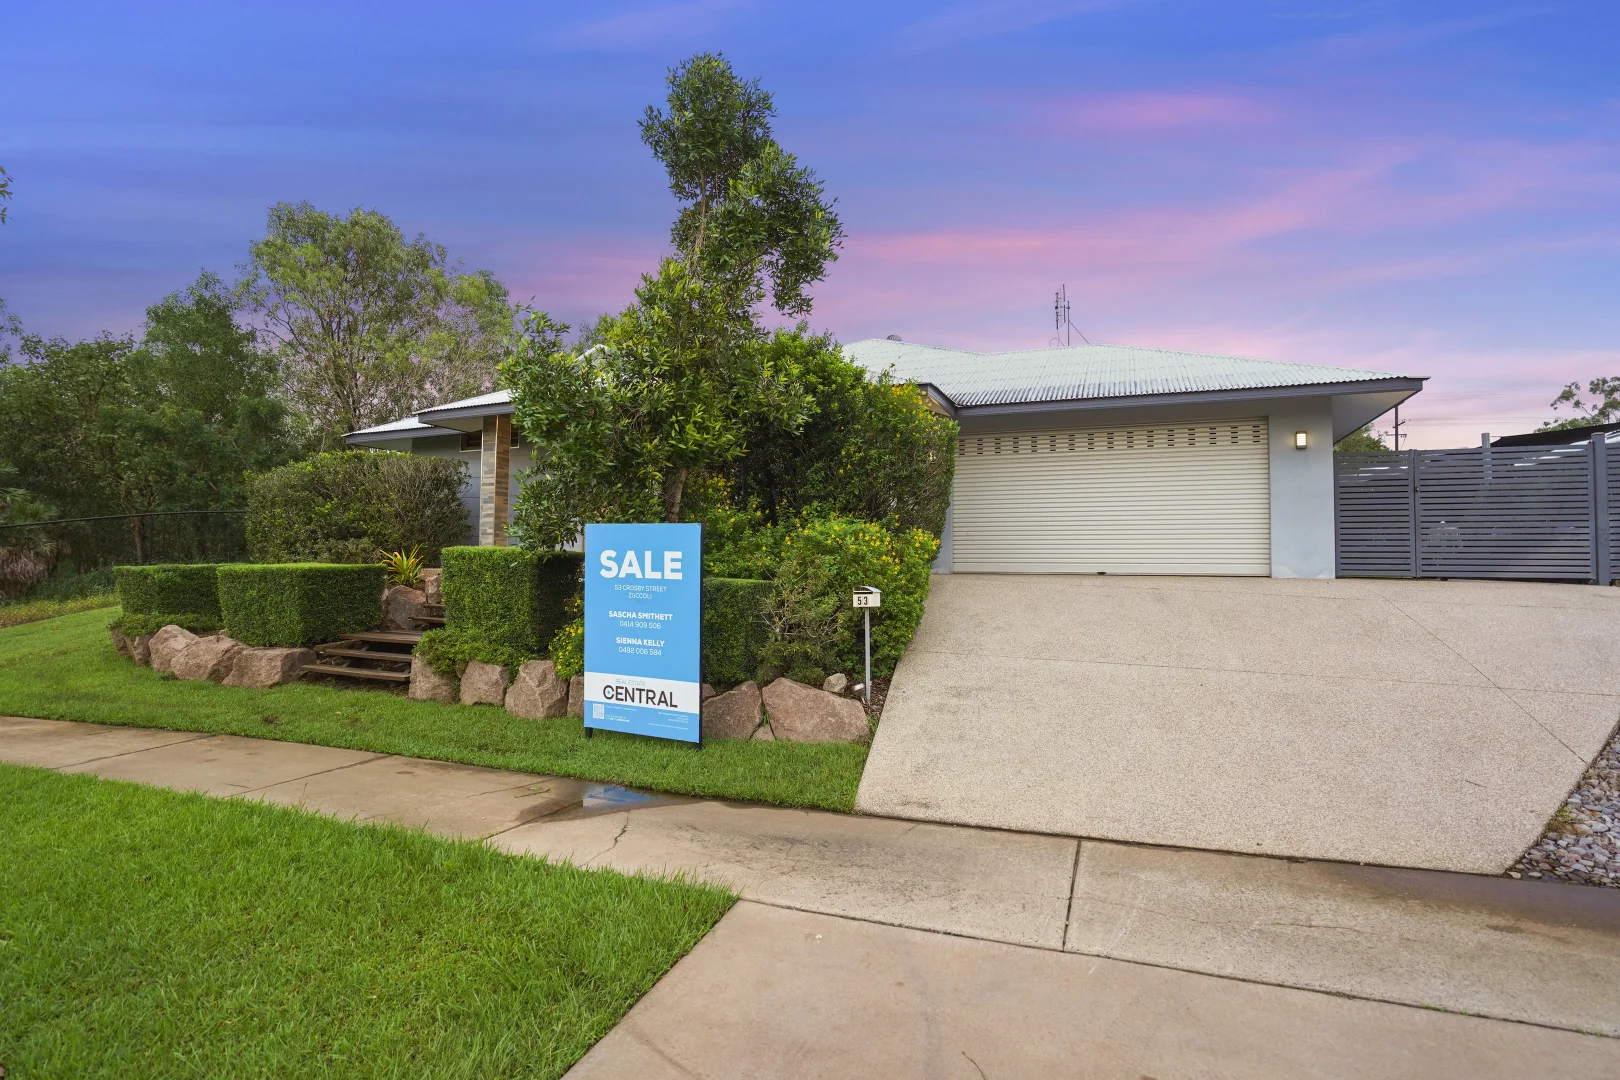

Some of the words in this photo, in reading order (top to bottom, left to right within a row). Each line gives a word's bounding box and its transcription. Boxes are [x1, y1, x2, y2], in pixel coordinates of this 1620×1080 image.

[599, 549, 683, 580] SALE
[857, 596, 868, 605] 53
[608, 610, 637, 619] SASCHA
[638, 612, 673, 621] SMITHETT
[619, 620, 634, 628] 0414
[616, 637, 642, 646] SIENNA
[643, 638, 665, 648] KELLY
[618, 646, 634, 654] 0492
[636, 647, 648, 655] 006
[603, 684, 678, 708] CENTRAL
